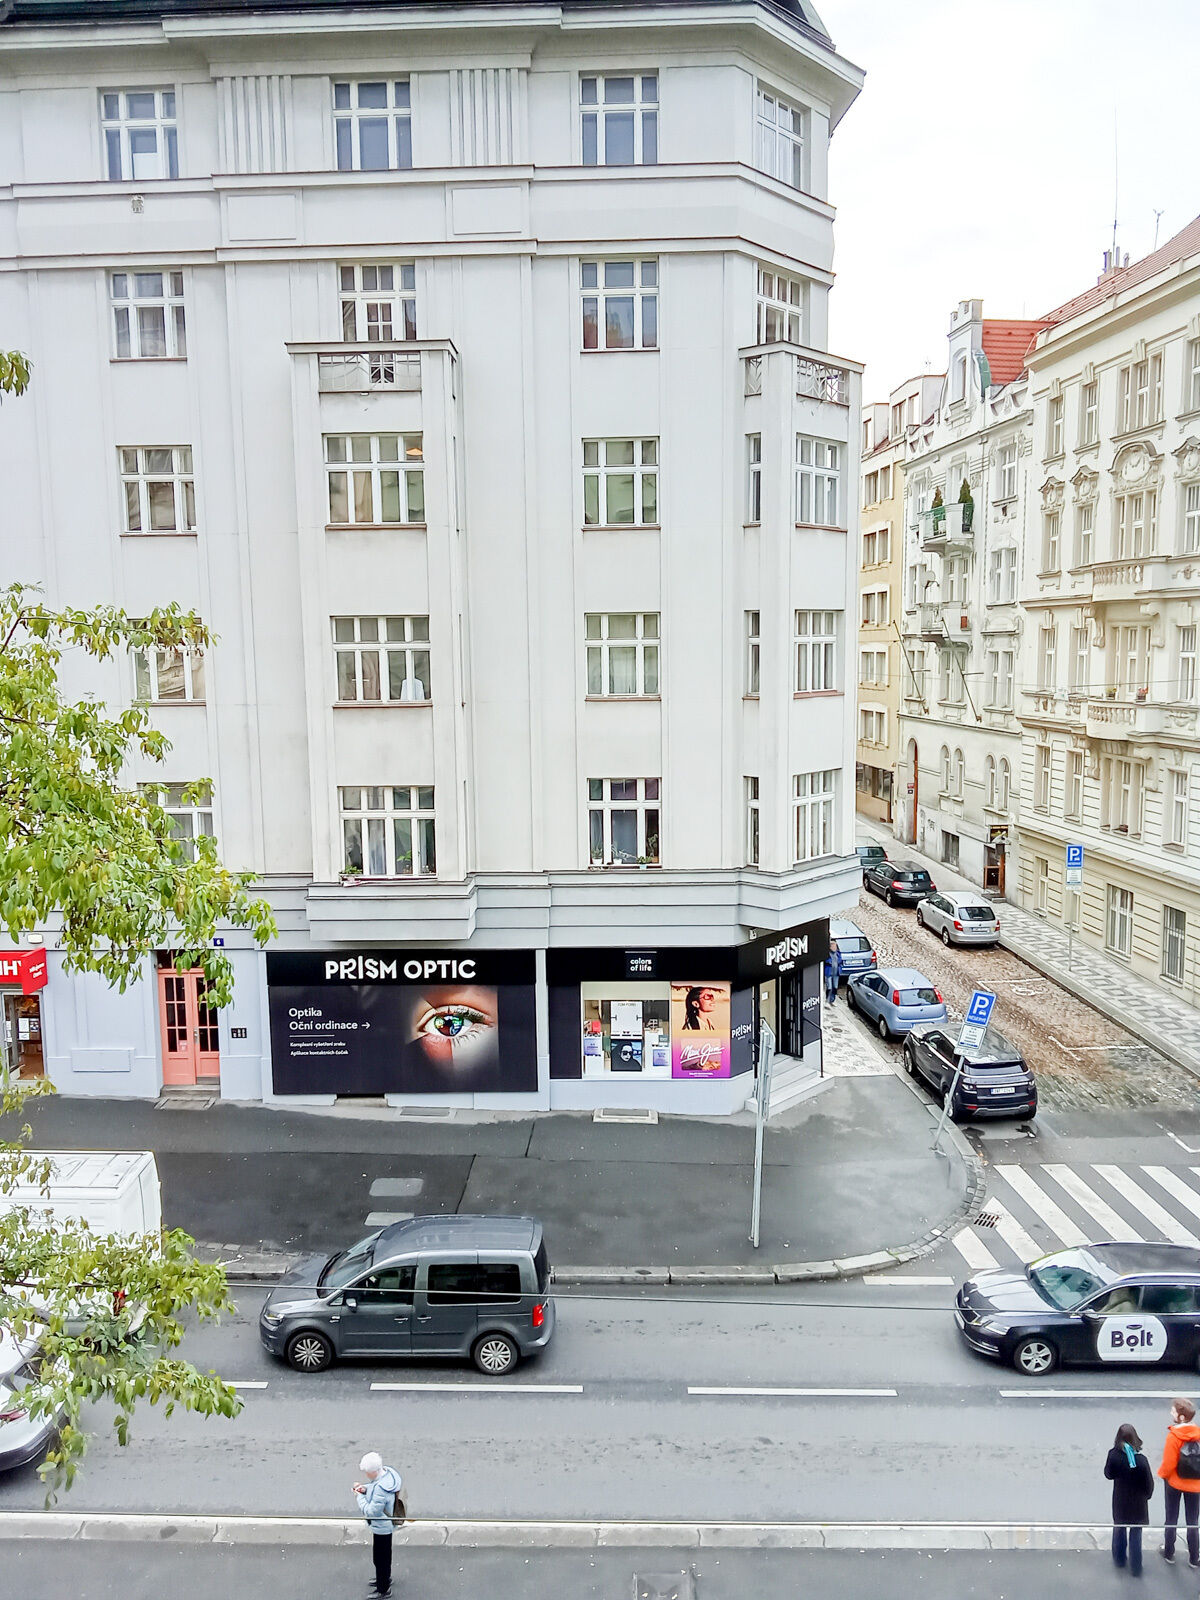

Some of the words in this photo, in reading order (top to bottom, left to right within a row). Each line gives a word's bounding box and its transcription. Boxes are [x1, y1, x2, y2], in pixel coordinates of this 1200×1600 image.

[1069, 847, 1081, 861] P
[766, 934, 809, 966] PRISM
[325, 955, 397, 980] PRISM
[403, 959, 477, 980] OPTIC
[630, 957, 652, 965] colors
[802, 996, 820, 1011] PRISM
[972, 996, 990, 1015] P
[288, 1007, 322, 1020] Optika
[289, 1020, 313, 1030] Oční
[314, 1020, 358, 1030] ordinace
[731, 1023, 752, 1039] PRISM
[1111, 1330, 1153, 1348] Bolt
